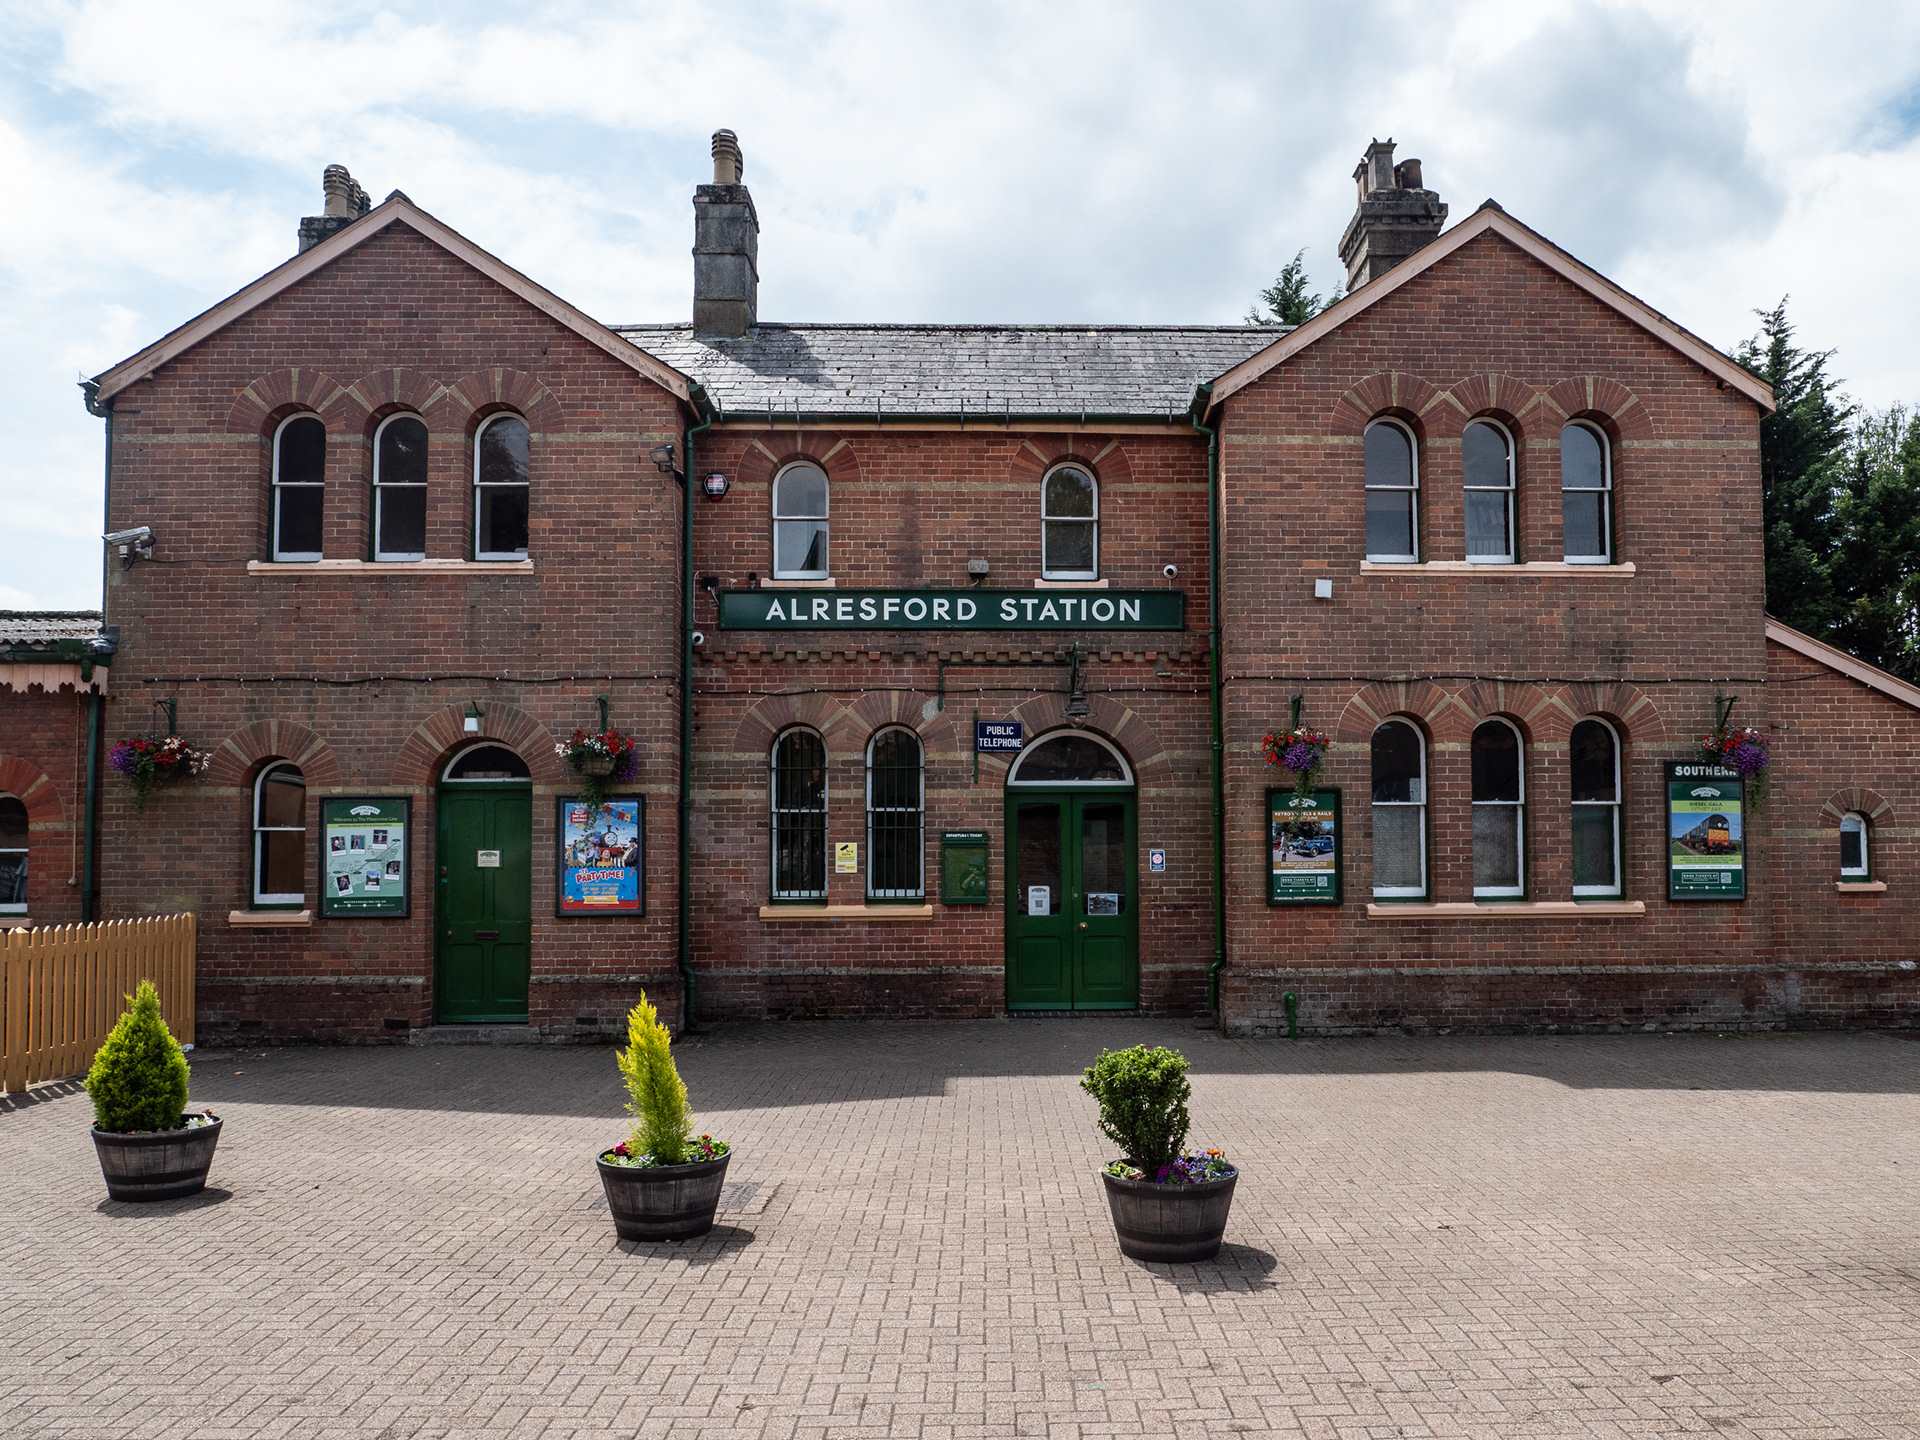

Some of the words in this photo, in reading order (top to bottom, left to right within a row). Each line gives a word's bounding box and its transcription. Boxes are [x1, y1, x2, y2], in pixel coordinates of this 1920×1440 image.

[765, 597, 978, 622] ALRESFORD
[1000, 597, 1141, 622] STATION
[986, 725, 1014, 735] PUBLIC
[978, 738, 1022, 748] TELEPHONE
[1692, 788, 1719, 796] WATERCRESS
